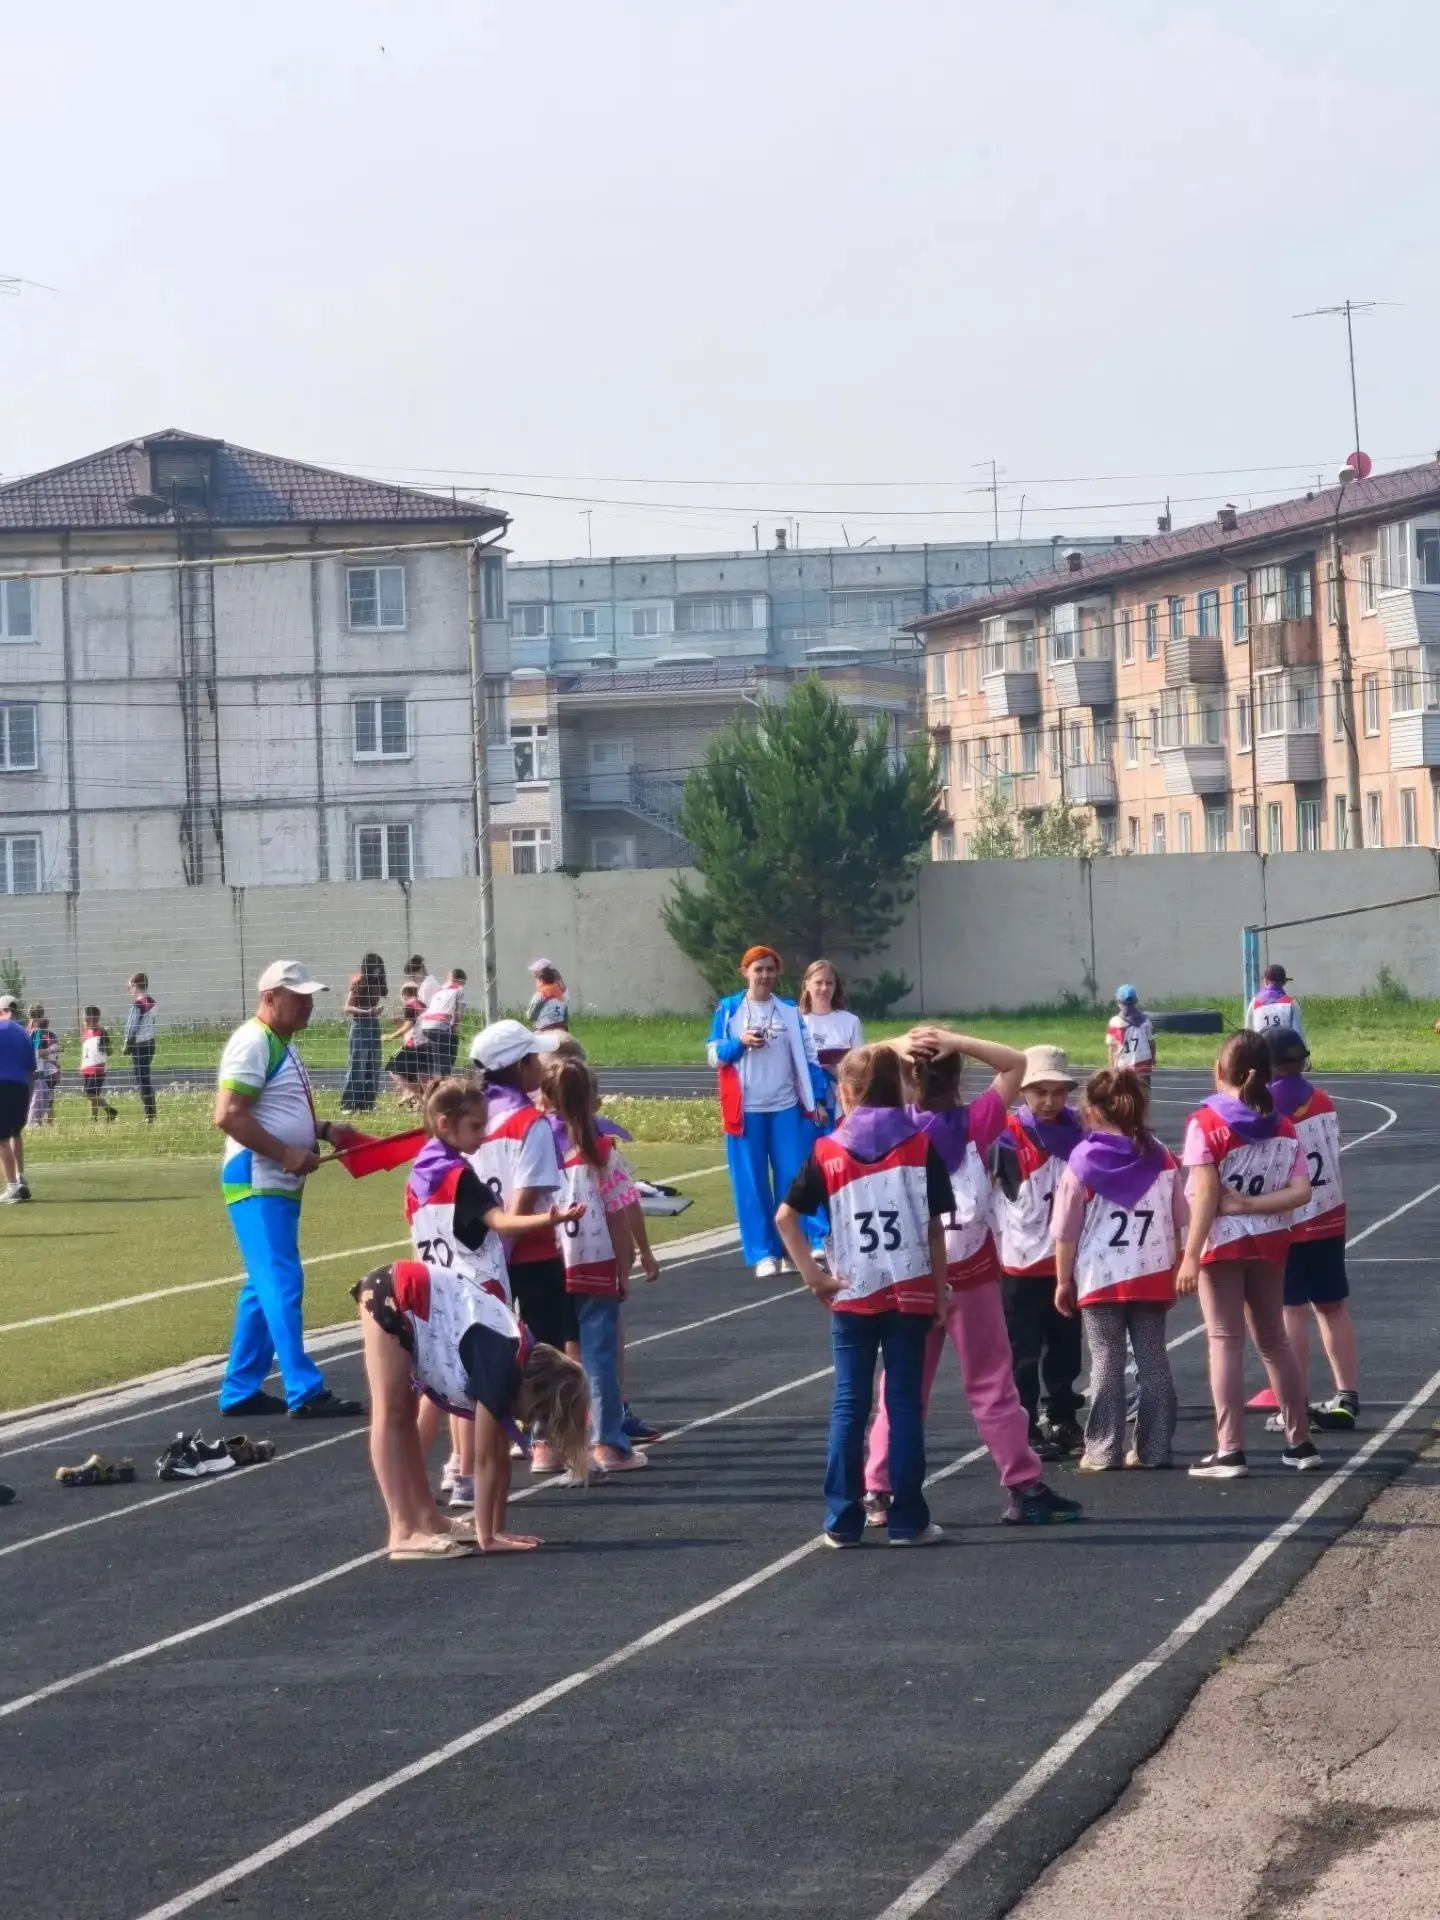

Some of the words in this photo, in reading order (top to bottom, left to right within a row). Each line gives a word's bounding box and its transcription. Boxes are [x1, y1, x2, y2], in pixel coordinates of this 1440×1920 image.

[1124, 1038, 1139, 1054] 17
[854, 1210, 901, 1253] 33
[1109, 1210, 1154, 1247] 27
[417, 1237, 454, 1268] 30
